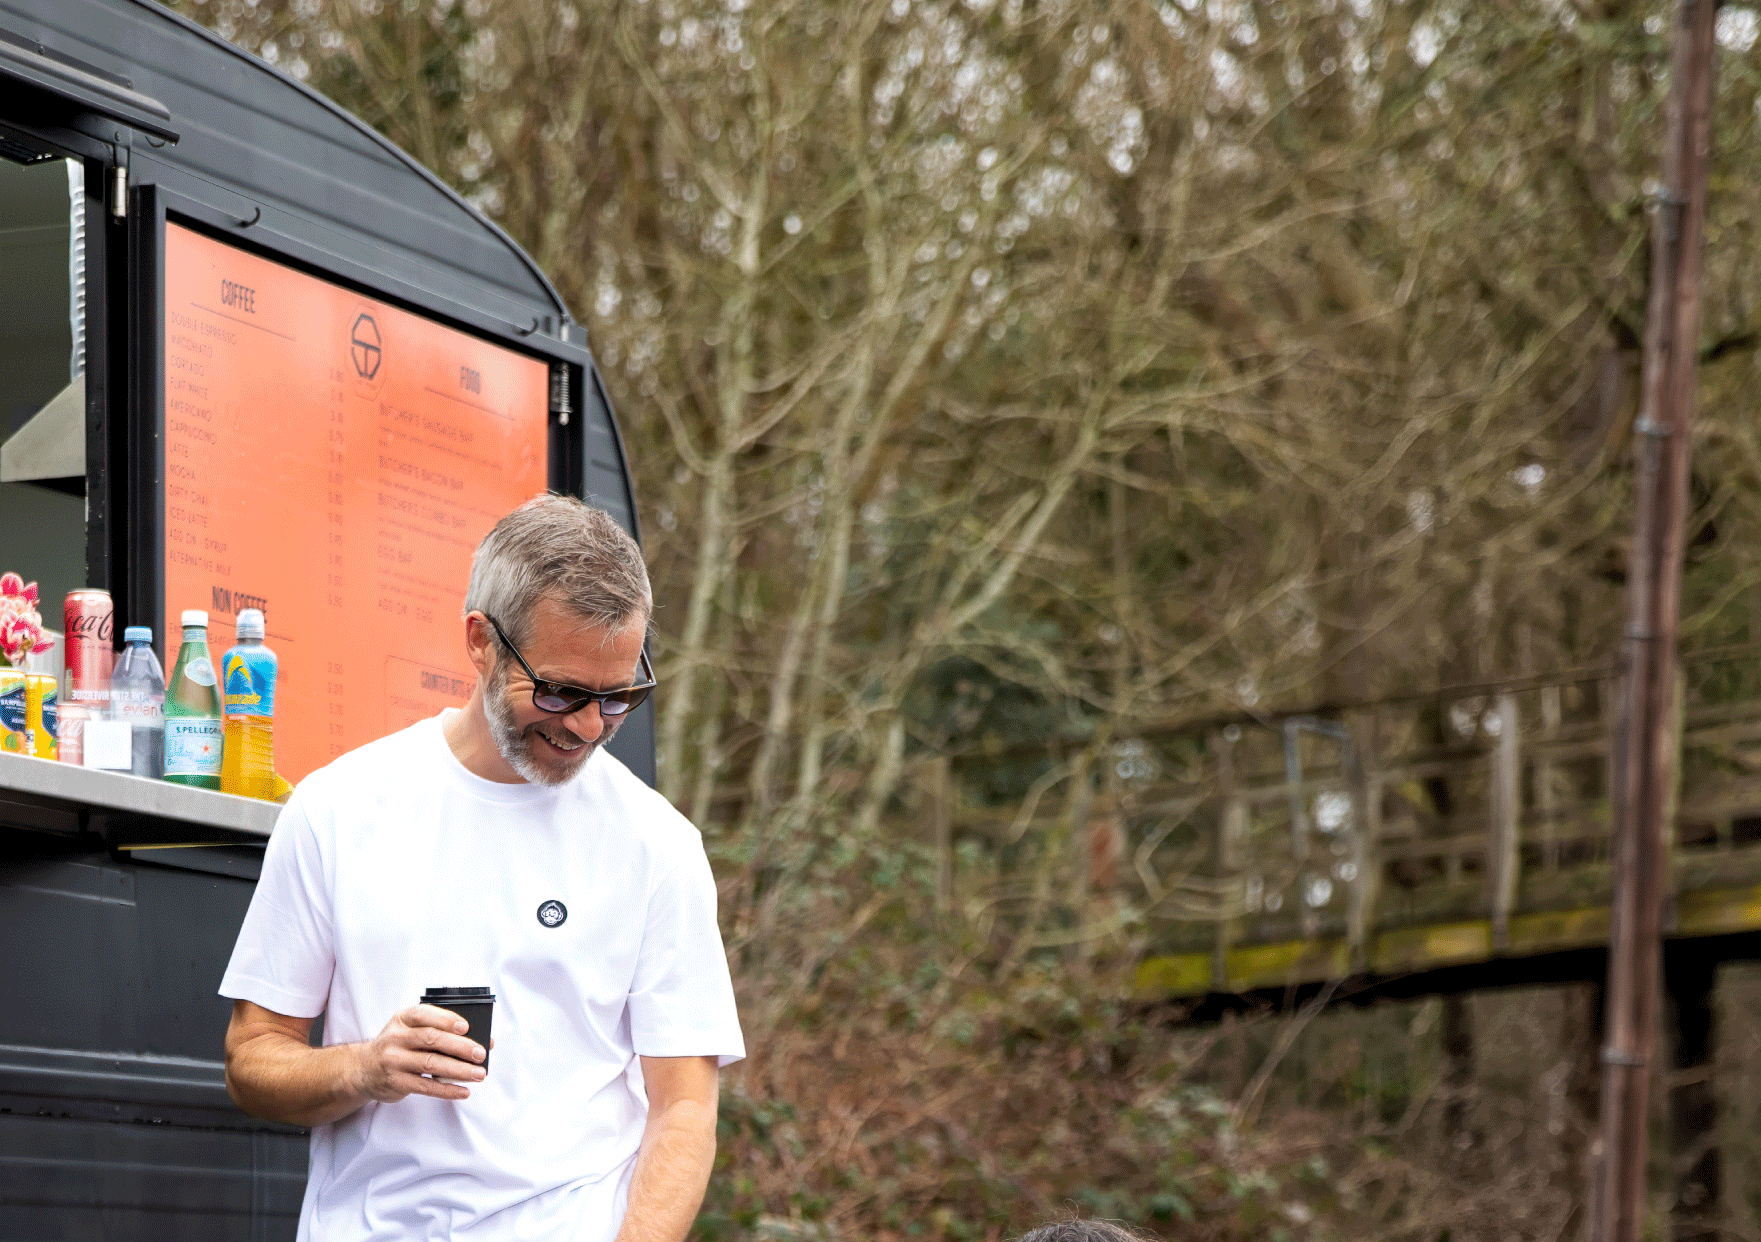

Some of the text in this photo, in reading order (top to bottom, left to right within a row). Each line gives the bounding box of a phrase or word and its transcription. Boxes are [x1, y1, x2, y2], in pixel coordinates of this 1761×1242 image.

[221, 279, 256, 314] COFFEE
[170, 398, 212, 422] AMERICANO
[211, 586, 232, 615] NON
[124, 704, 158, 718] evian
